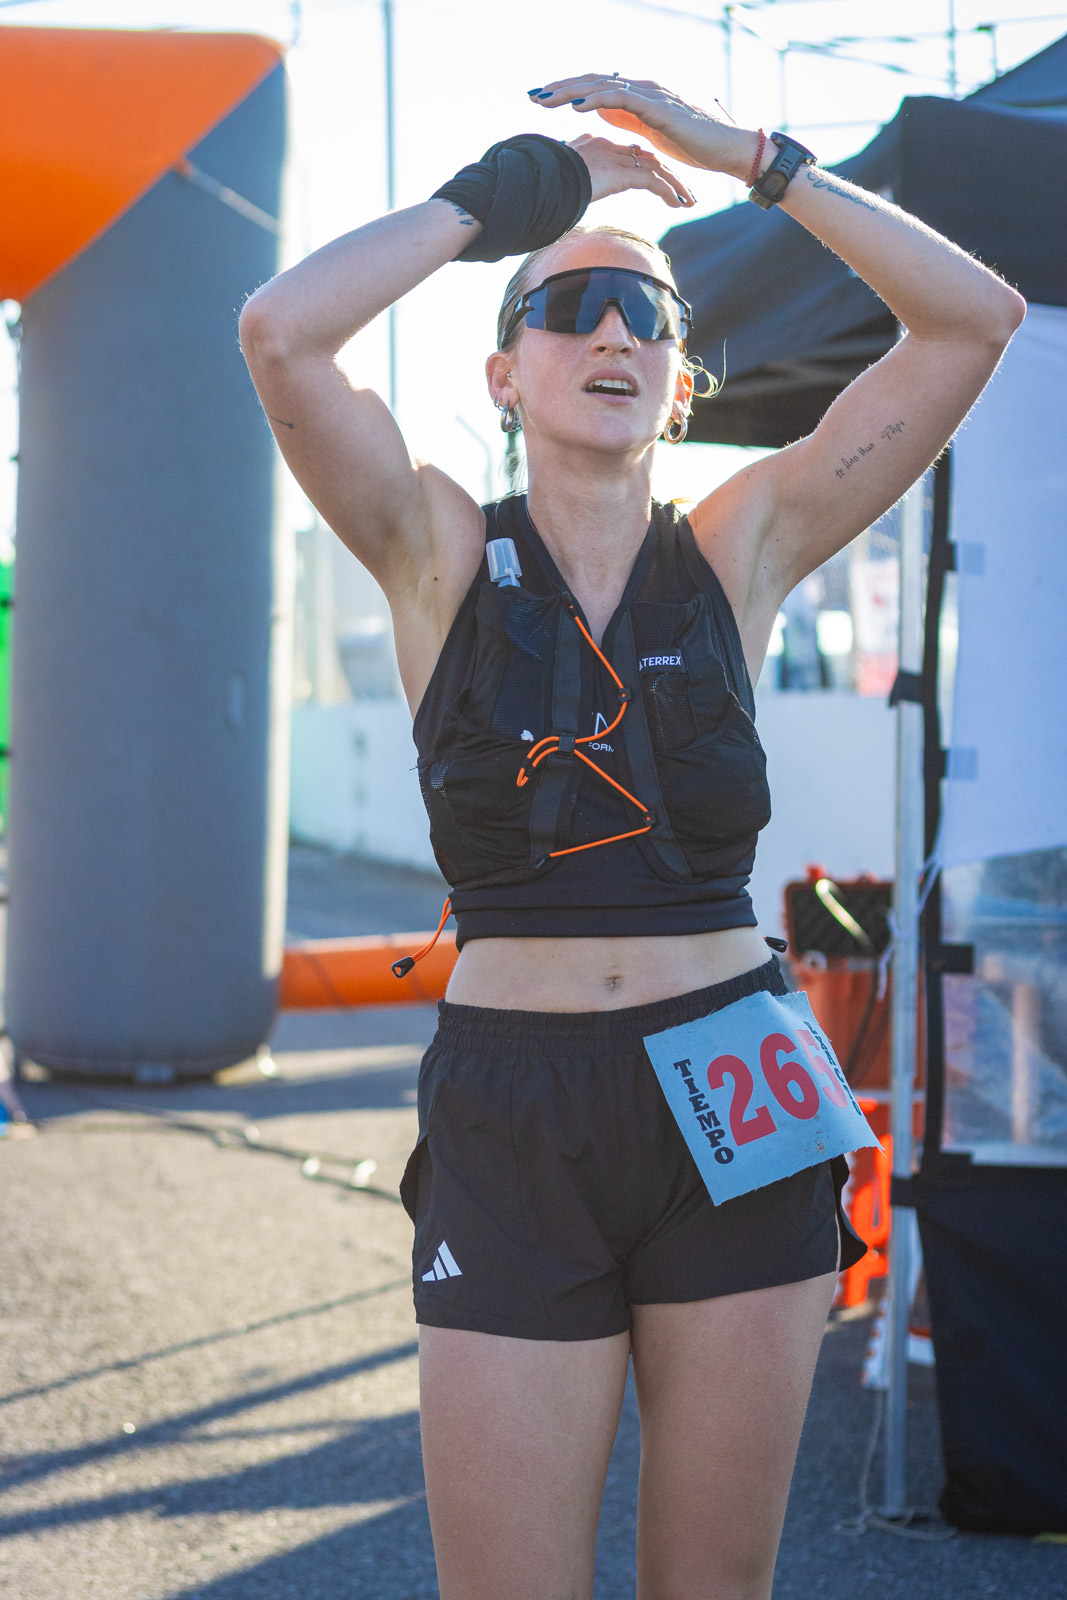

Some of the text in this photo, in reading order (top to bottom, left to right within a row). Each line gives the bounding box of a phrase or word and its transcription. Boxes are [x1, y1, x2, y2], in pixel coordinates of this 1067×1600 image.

[641, 655, 682, 668] TERREX
[673, 1058, 735, 1165] TIEMPO
[706, 1029, 849, 1147] 265
